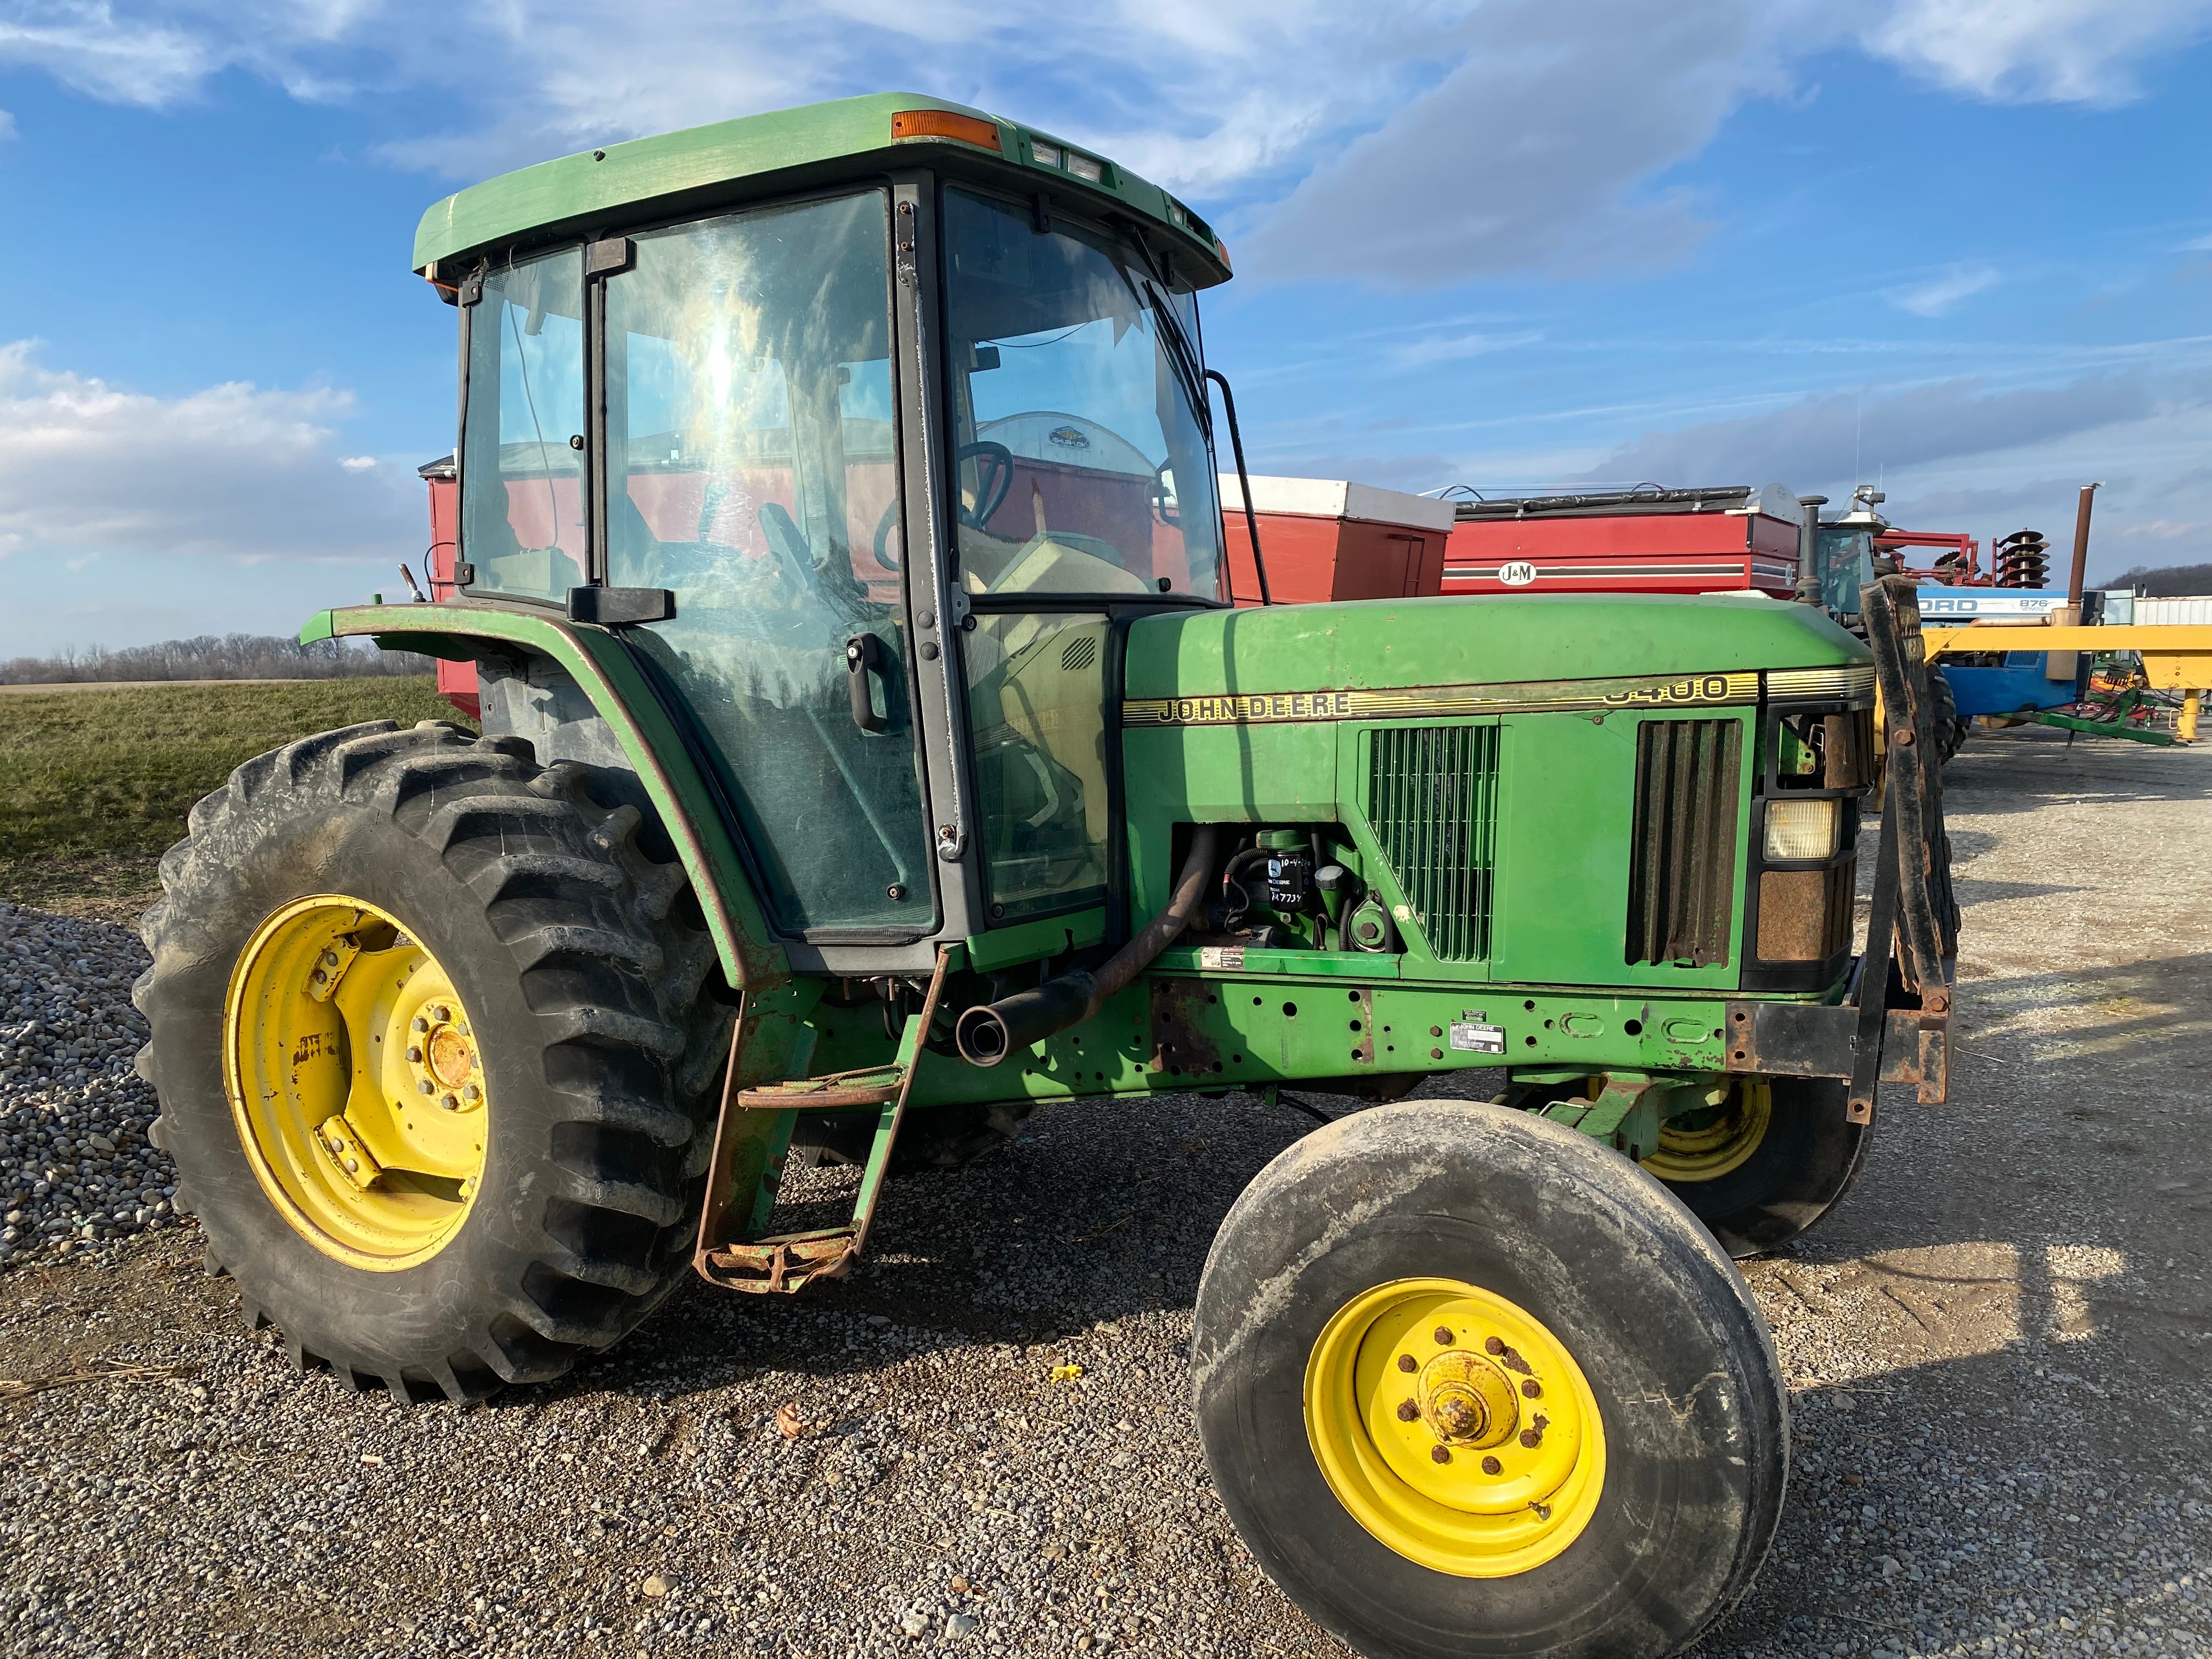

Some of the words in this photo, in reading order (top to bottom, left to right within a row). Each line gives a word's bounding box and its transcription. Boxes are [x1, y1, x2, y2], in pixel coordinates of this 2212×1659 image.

[1502, 565, 1531, 580] J&M
[1918, 600, 1977, 611] ORD
[1158, 698, 1238, 722] JOHN
[1248, 693, 1351, 718] DEERE
